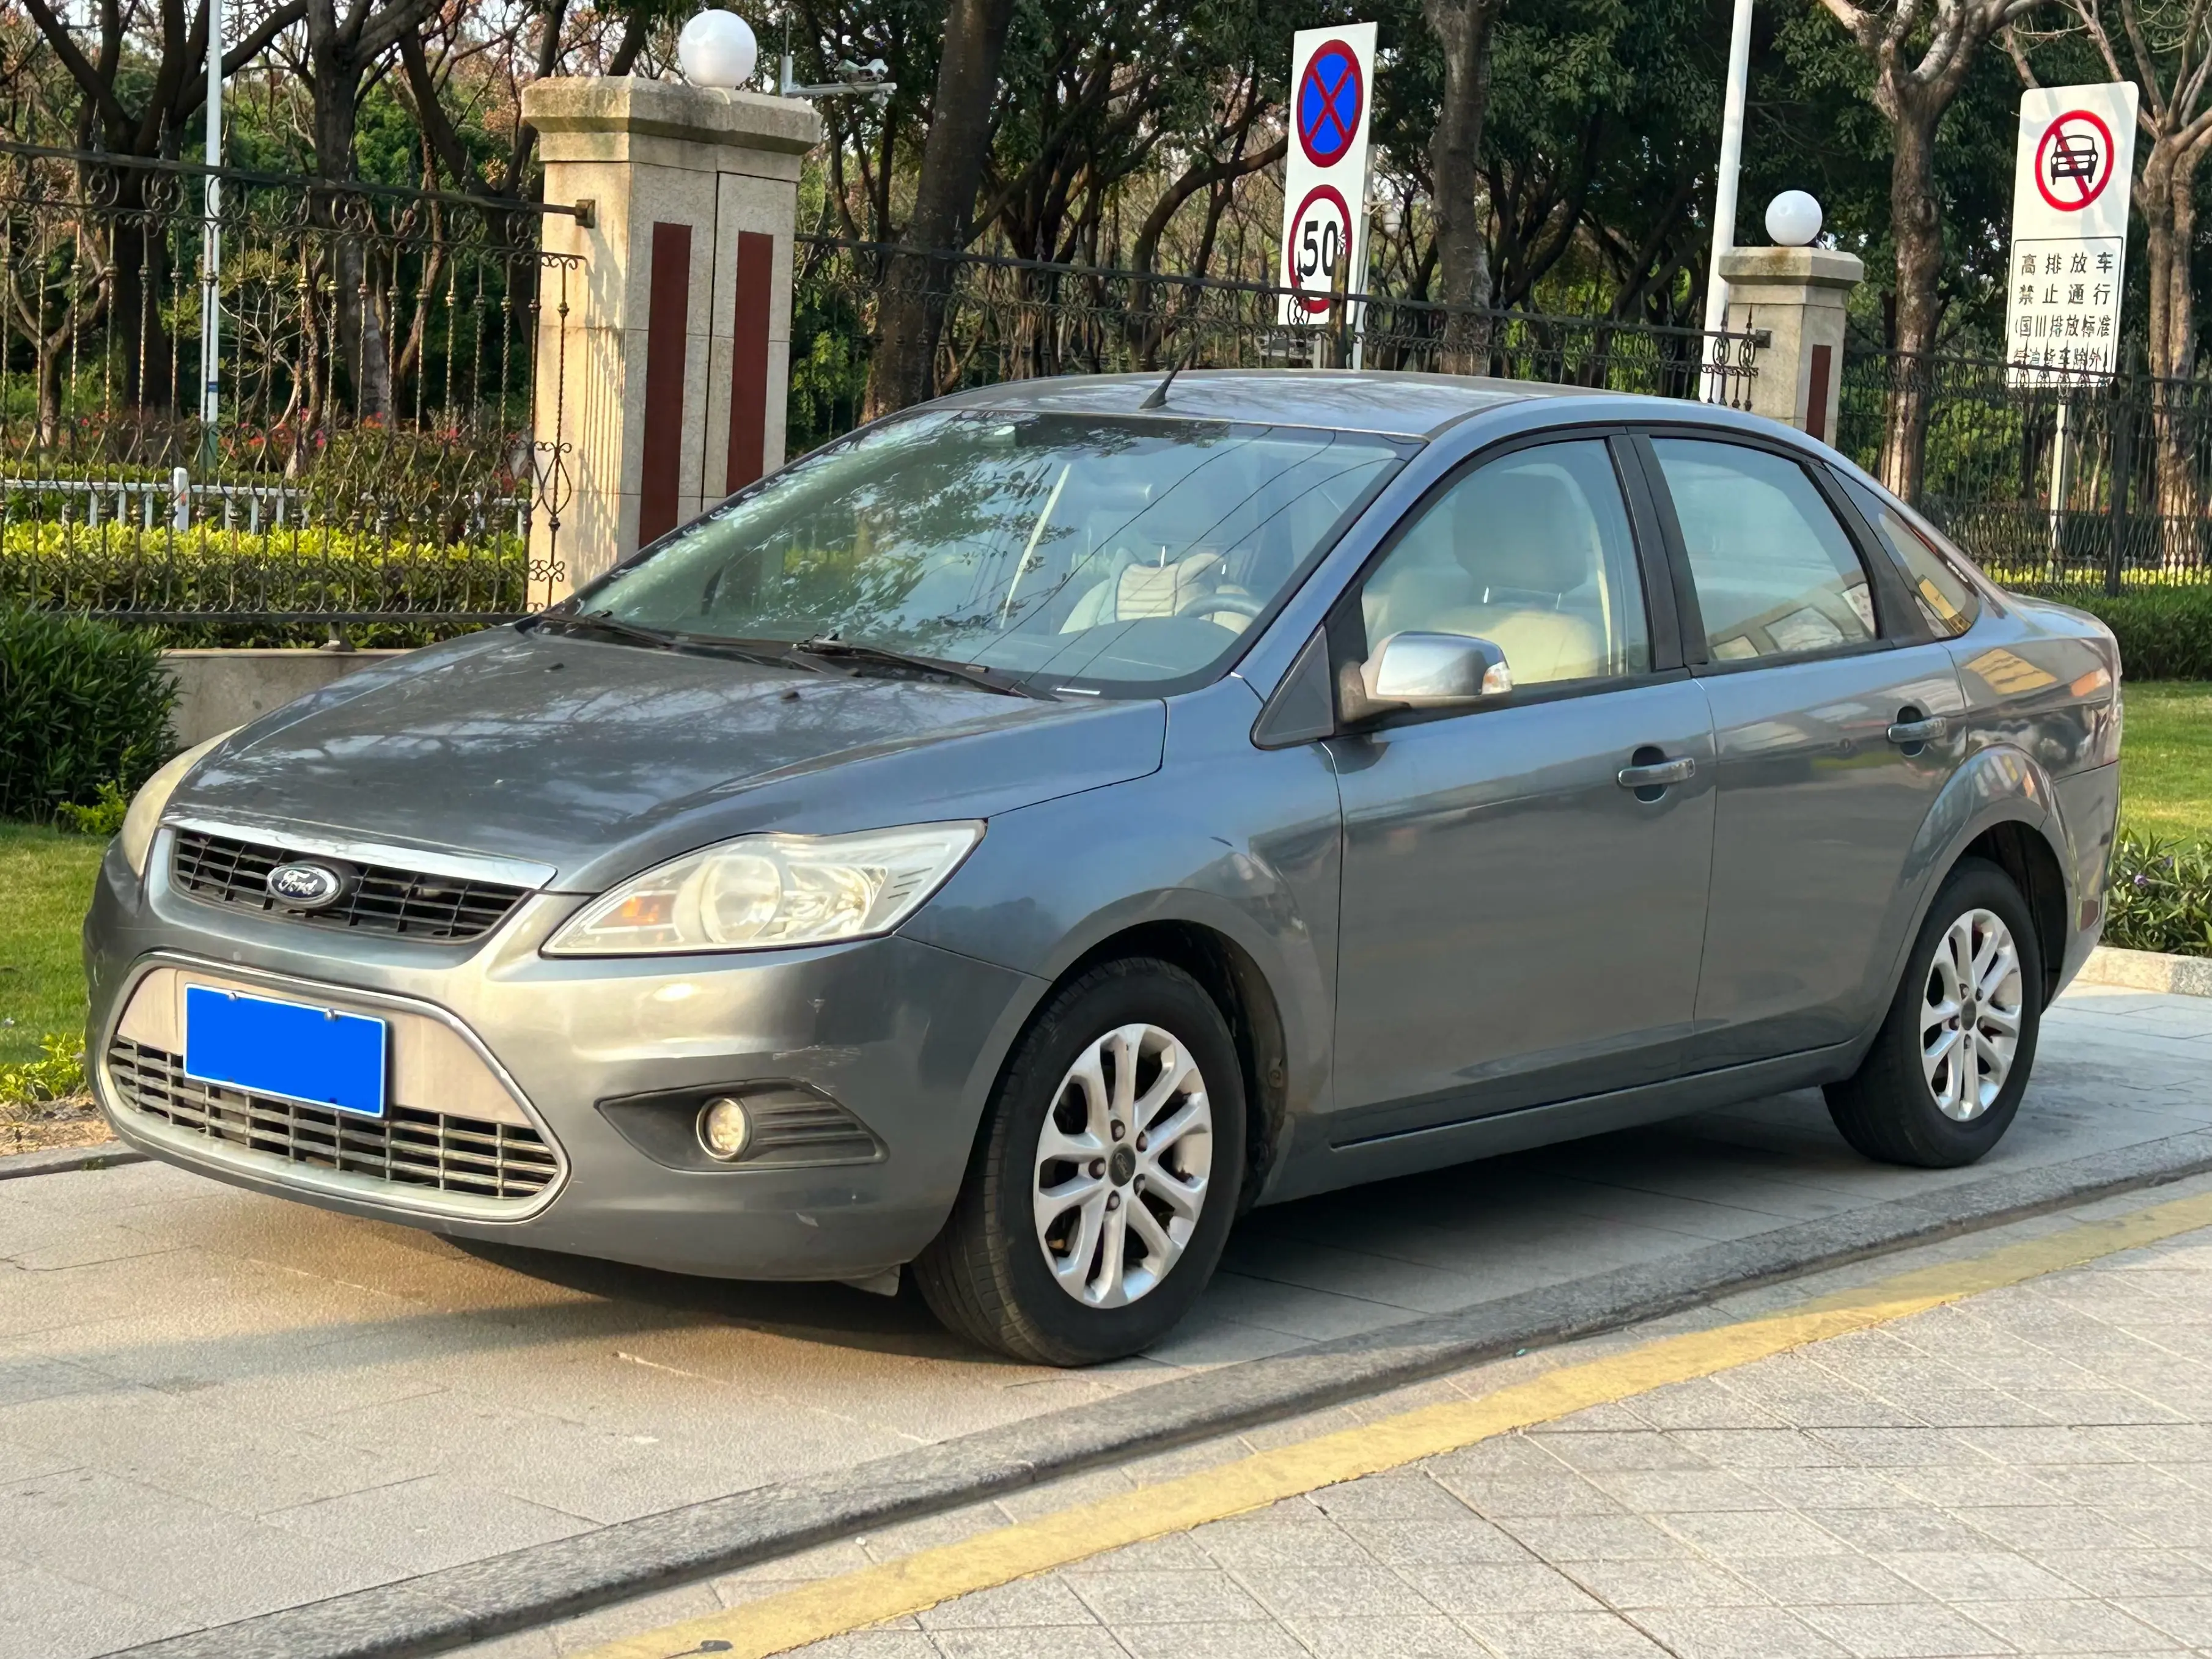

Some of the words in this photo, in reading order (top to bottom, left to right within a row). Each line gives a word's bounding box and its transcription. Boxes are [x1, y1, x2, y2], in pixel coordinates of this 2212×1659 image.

[1301, 220, 1338, 277] 50
[2021, 251, 2114, 276] 高排放车
[2018, 282, 2111, 305] 禁止通行
[278, 870, 318, 895] Ford
